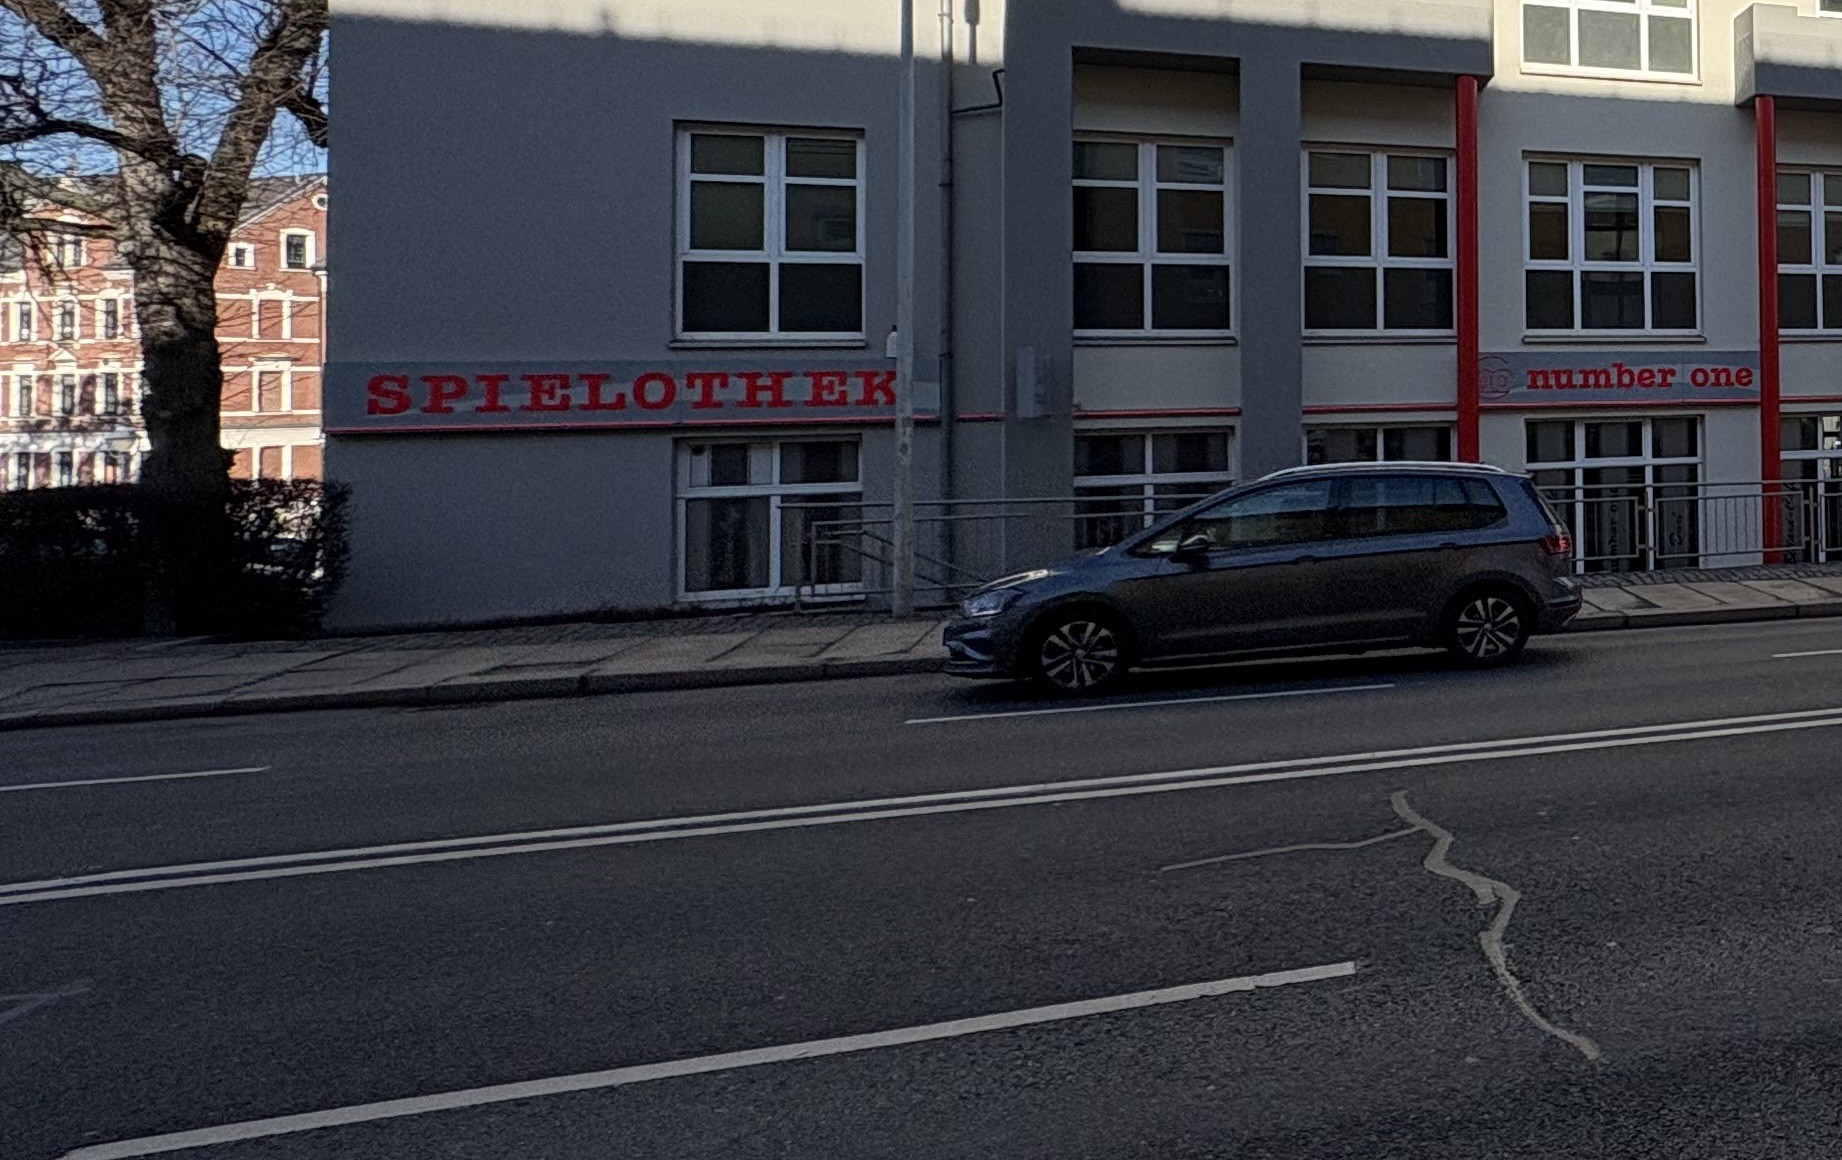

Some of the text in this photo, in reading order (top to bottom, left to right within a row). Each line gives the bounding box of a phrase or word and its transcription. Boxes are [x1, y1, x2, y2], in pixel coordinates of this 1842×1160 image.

[366, 370, 897, 415] SPIELOTHEK
[1526, 362, 1677, 390] number
[1690, 366, 1754, 388] one
